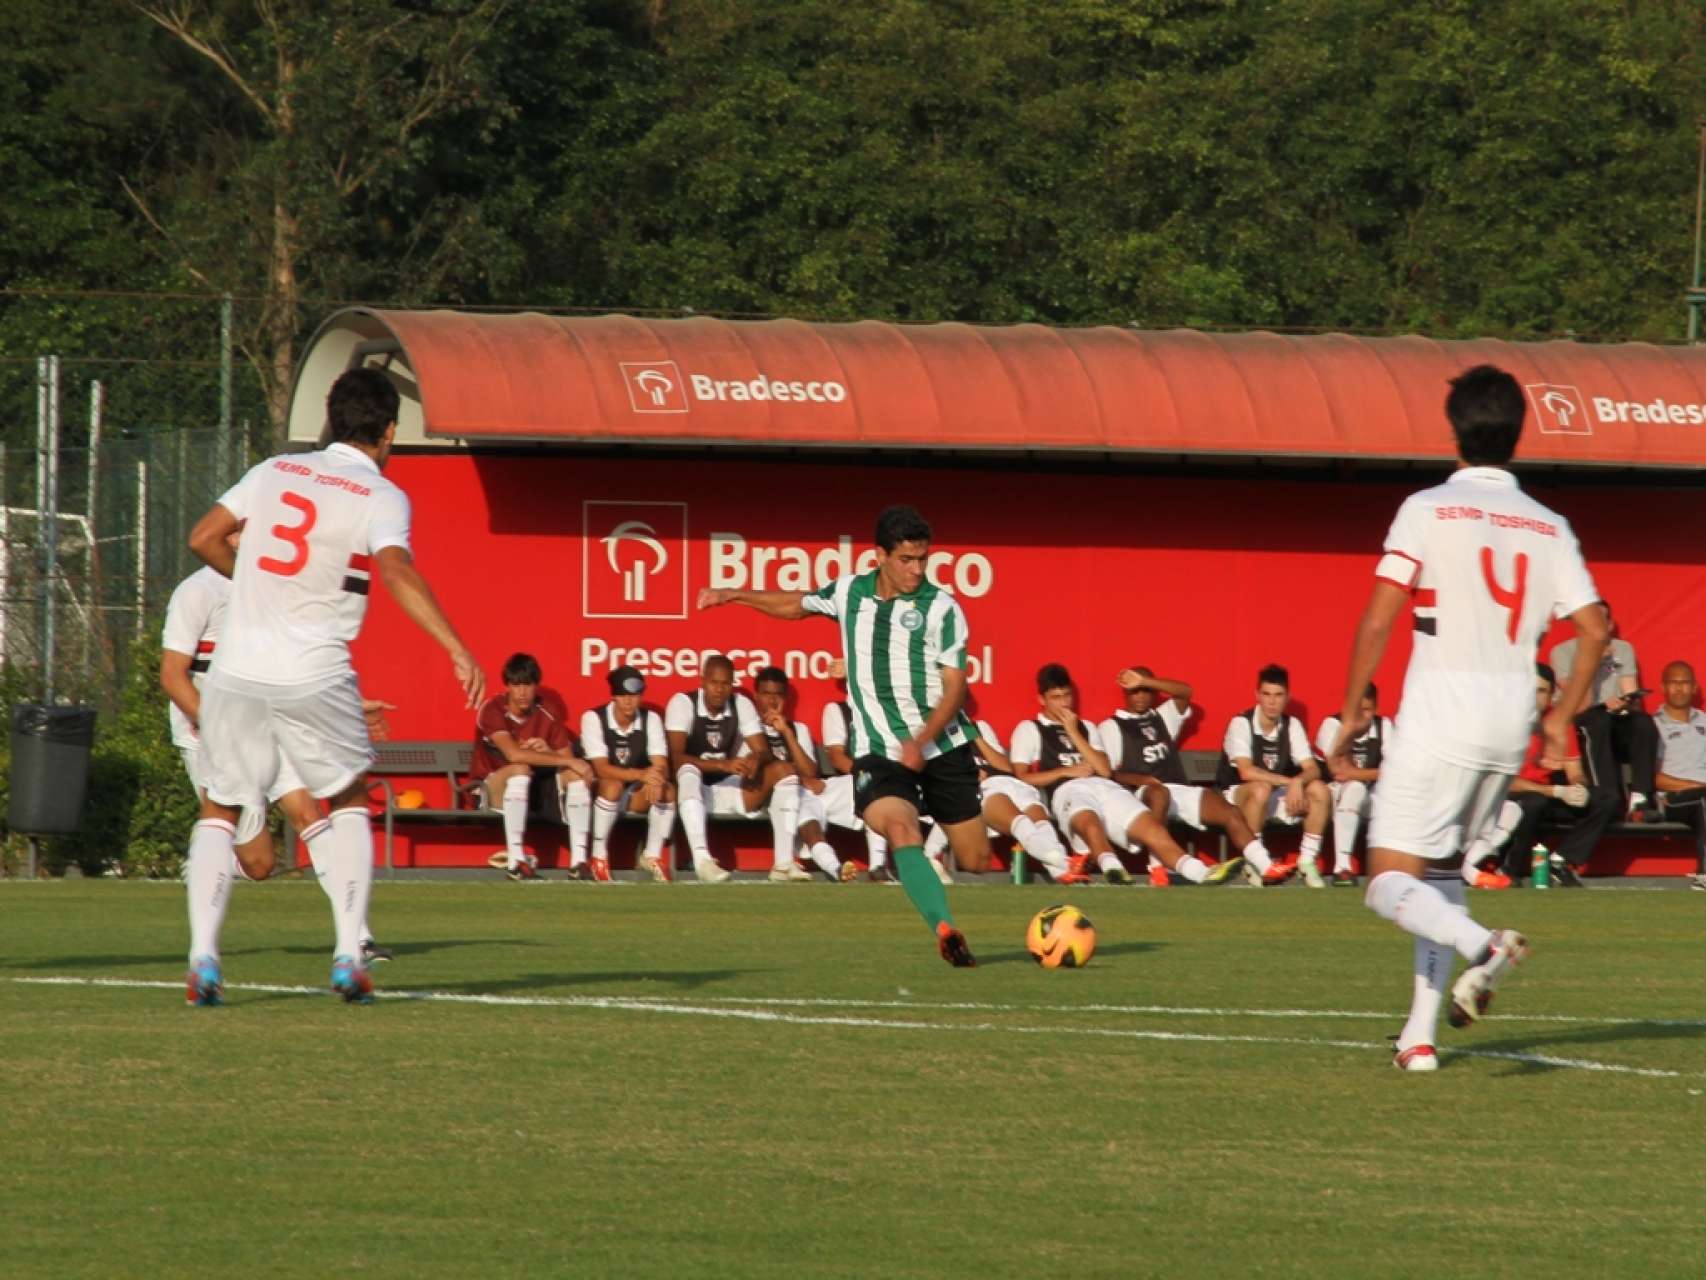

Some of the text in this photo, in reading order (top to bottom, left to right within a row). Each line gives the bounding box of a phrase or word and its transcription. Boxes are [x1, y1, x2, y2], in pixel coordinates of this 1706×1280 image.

[690, 374, 845, 403] Bradesco
[1592, 397, 1706, 425] Brades
[315, 474, 371, 496] TOSHIBA
[257, 491, 317, 576] 3
[1435, 506, 1558, 537] SEMP TOSHIBA
[1480, 546, 1529, 645] 4
[785, 650, 834, 680] no
